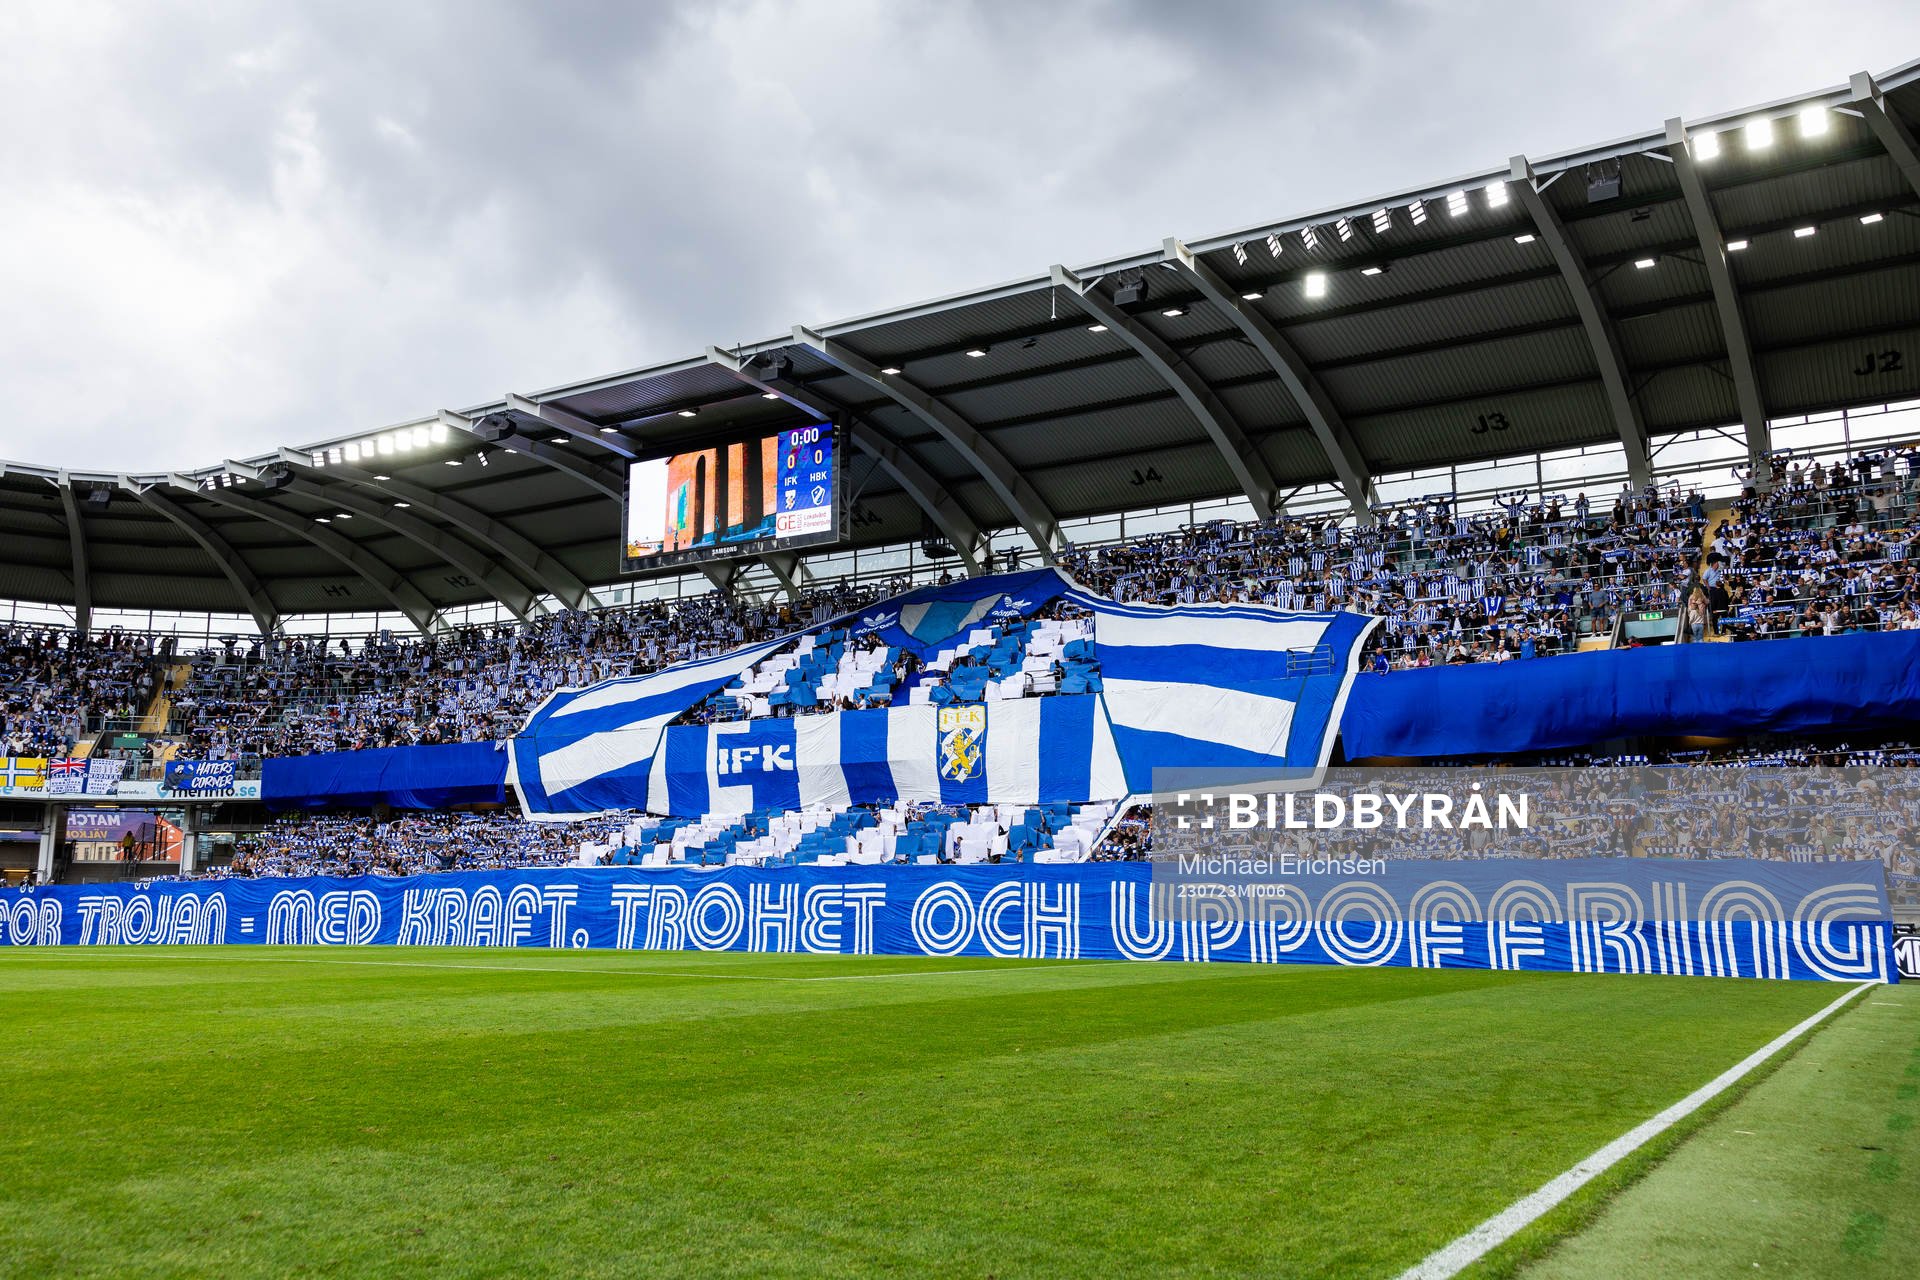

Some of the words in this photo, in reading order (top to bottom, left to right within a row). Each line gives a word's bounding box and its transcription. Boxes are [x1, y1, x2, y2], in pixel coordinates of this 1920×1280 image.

[1854, 351, 1903, 375] J2
[1471, 412, 1510, 434] J3
[791, 428, 819, 446] 0:00
[787, 454, 795, 469] 0
[815, 450, 823, 464] 0
[784, 477, 798, 486] IFK
[810, 471, 828, 482] HBK
[1131, 467, 1163, 485] J4
[777, 514, 796, 532] GE
[322, 585, 351, 597] H1
[444, 575, 475, 589] H2
[196, 761, 233, 775] HATERS
[718, 744, 794, 775] IFK
[191, 775, 234, 788] CORNER
[77, 881, 228, 945] TRÖJAN
[266, 889, 382, 946] MED
[611, 882, 887, 955] TROHET
[911, 881, 1080, 959] OCH
[1111, 881, 1889, 984] UPPOFFRING
